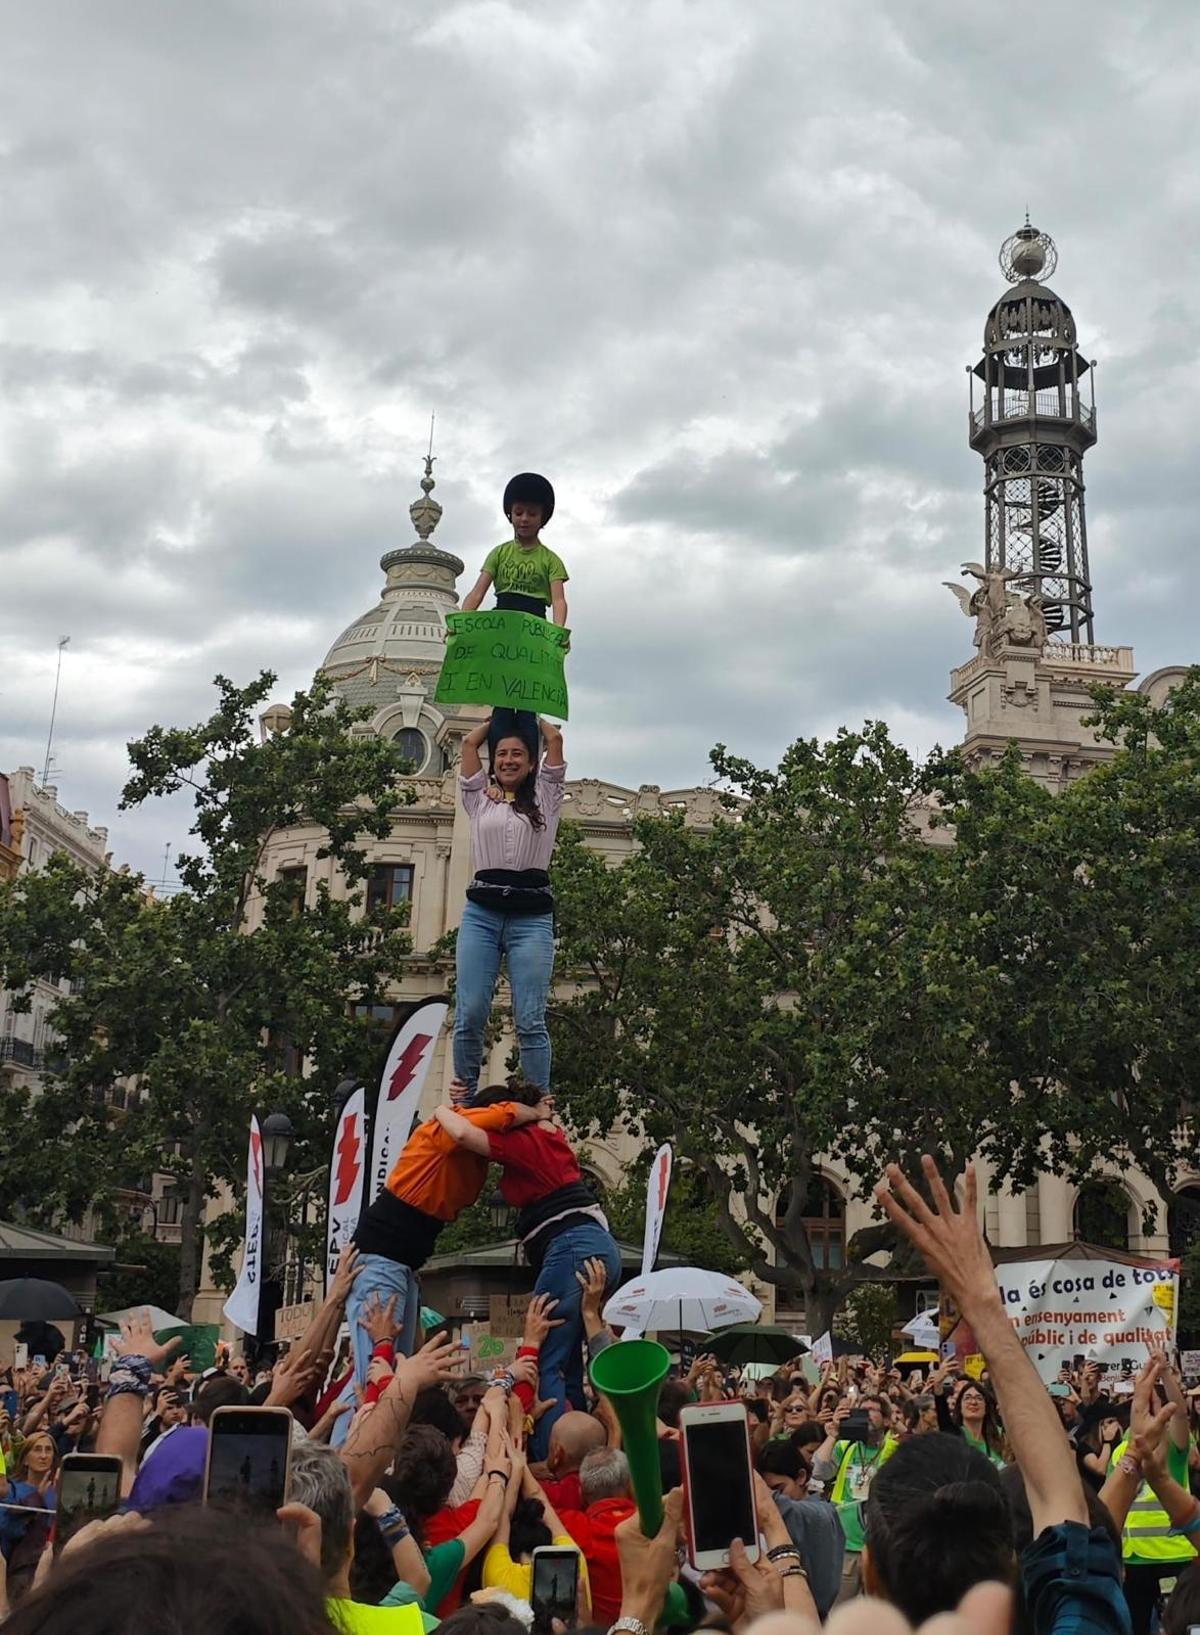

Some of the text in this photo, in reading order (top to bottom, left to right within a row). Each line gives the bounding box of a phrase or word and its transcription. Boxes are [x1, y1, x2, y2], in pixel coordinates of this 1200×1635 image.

[453, 617, 506, 635] ESCOLA
[454, 645, 475, 660] DE
[440, 672, 458, 691] I
[465, 672, 493, 691] EN
[999, 1286, 1020, 1305] la
[1029, 1280, 1046, 1299] és
[1052, 1276, 1095, 1295] cosa
[1102, 1269, 1126, 1288] de
[1024, 1309, 1126, 1327] ensenyament
[1069, 1329, 1073, 1344] i
[1077, 1329, 1097, 1344] de
